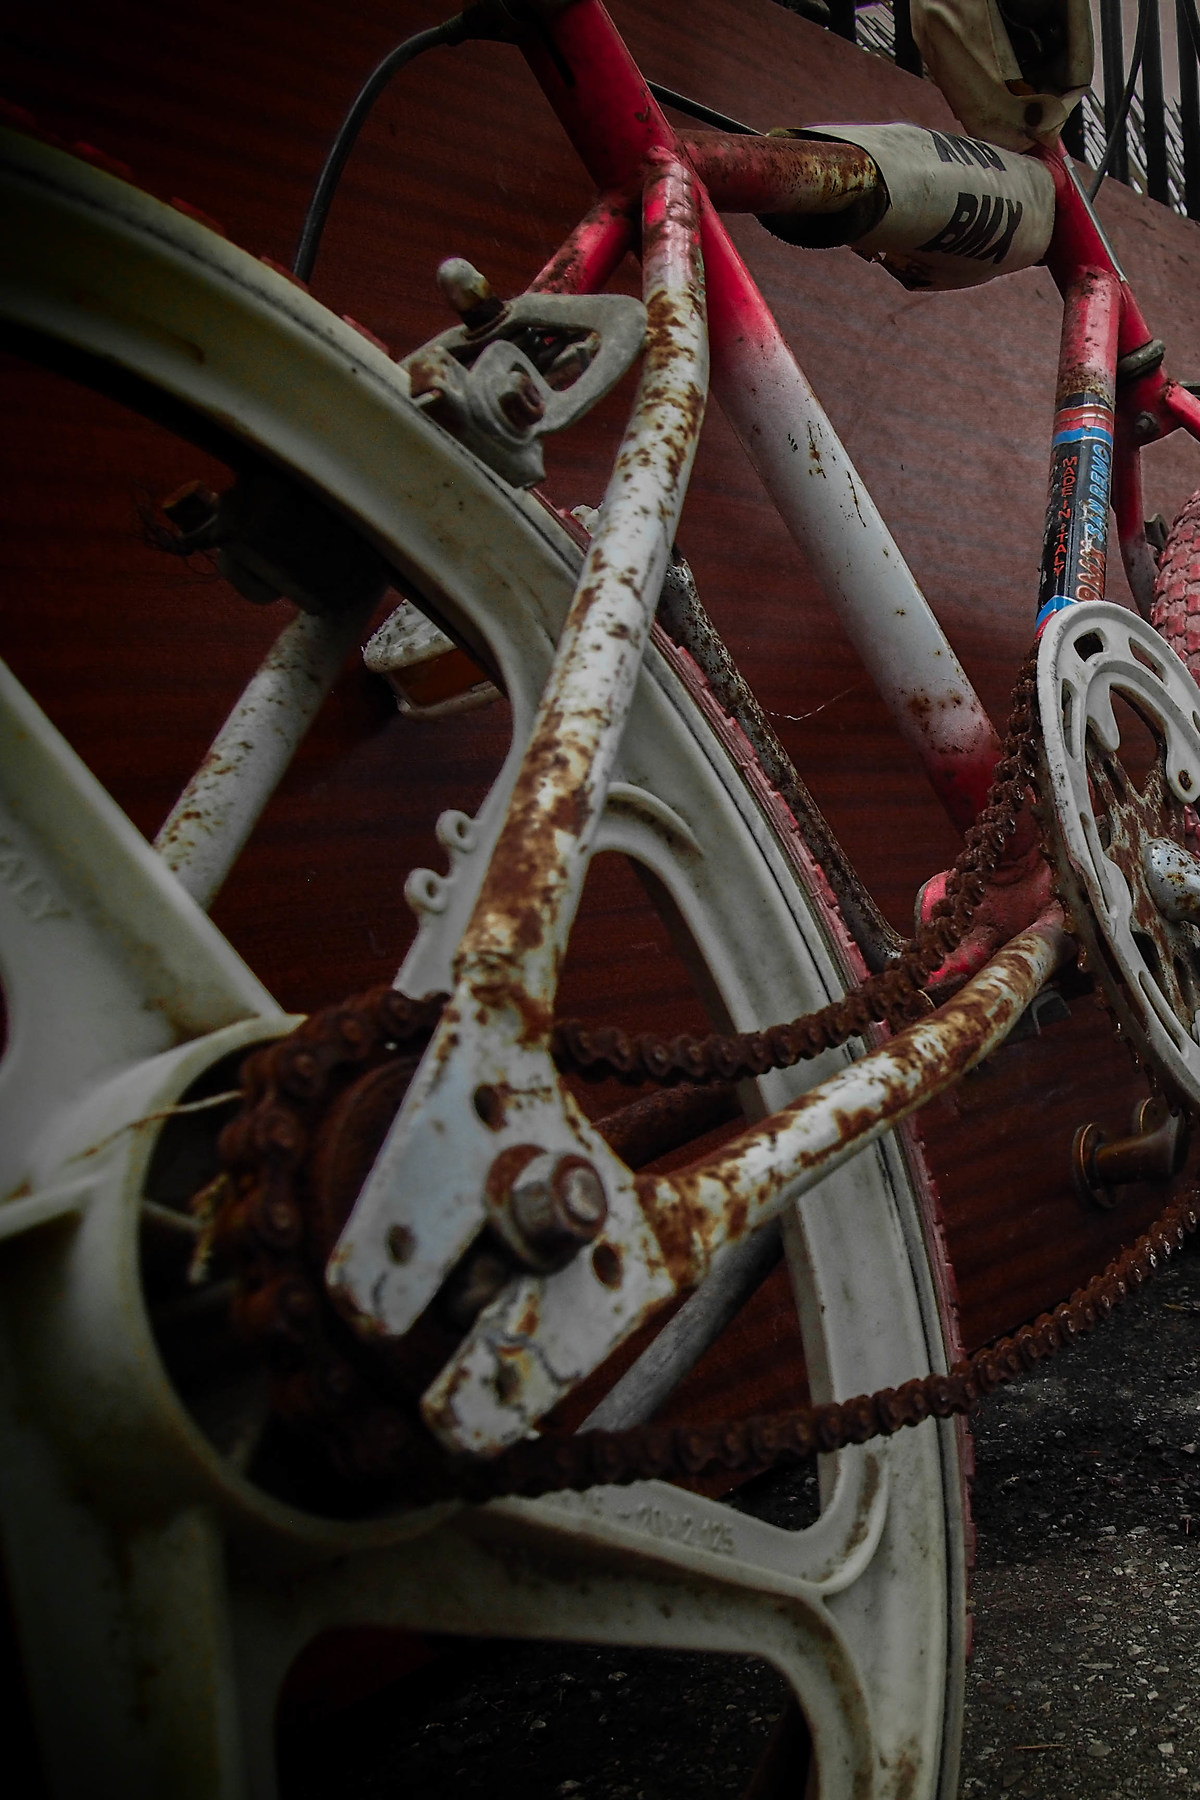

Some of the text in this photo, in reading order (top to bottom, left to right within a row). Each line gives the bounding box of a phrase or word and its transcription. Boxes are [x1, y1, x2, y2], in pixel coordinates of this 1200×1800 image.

[914, 192, 1023, 264] BMX
[1090, 444, 1111, 502] REMO
[1053, 456, 1078, 578] MADE IN ITALY
[1087, 498, 1106, 542] SAN
